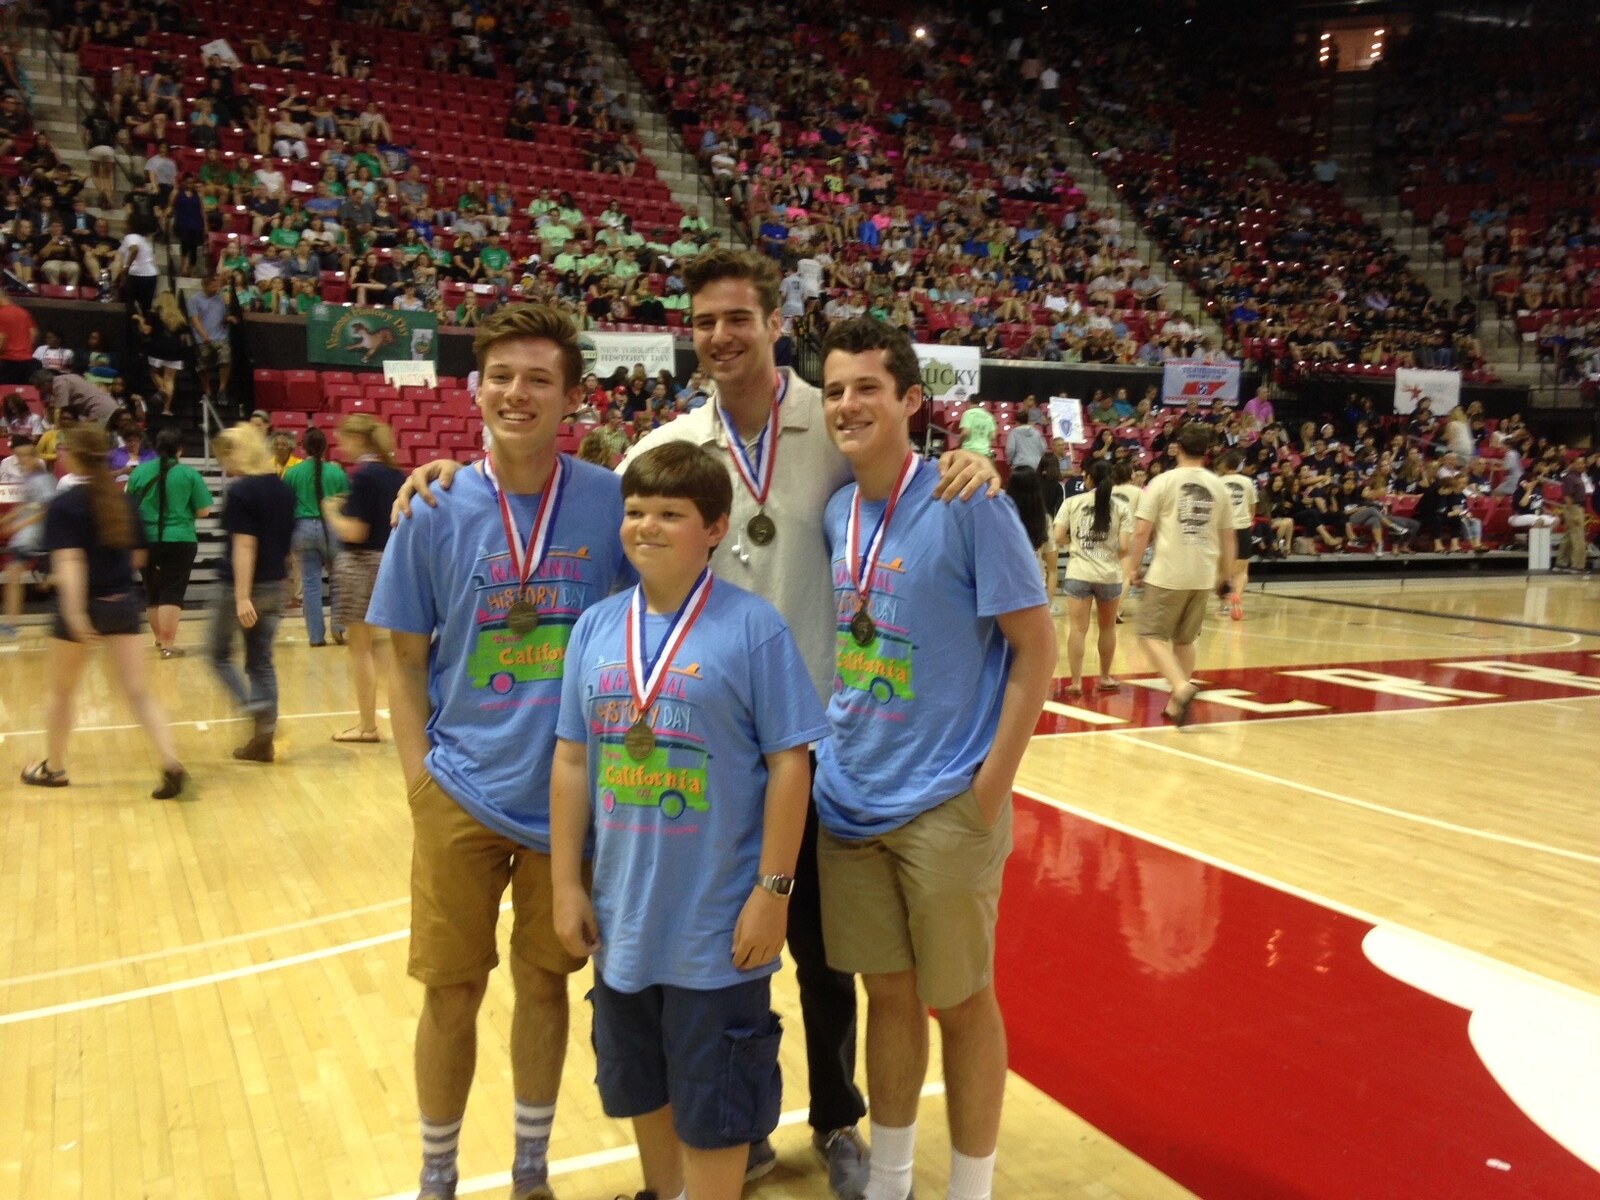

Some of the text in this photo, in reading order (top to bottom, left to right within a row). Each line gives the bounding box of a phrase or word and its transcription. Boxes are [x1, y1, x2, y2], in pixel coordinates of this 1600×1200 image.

[600, 354, 645, 362] HISTORY
[651, 354, 669, 362] DAY
[925, 368, 978, 386] UCKY
[663, 706, 692, 732] DAY
[605, 764, 701, 795] California
